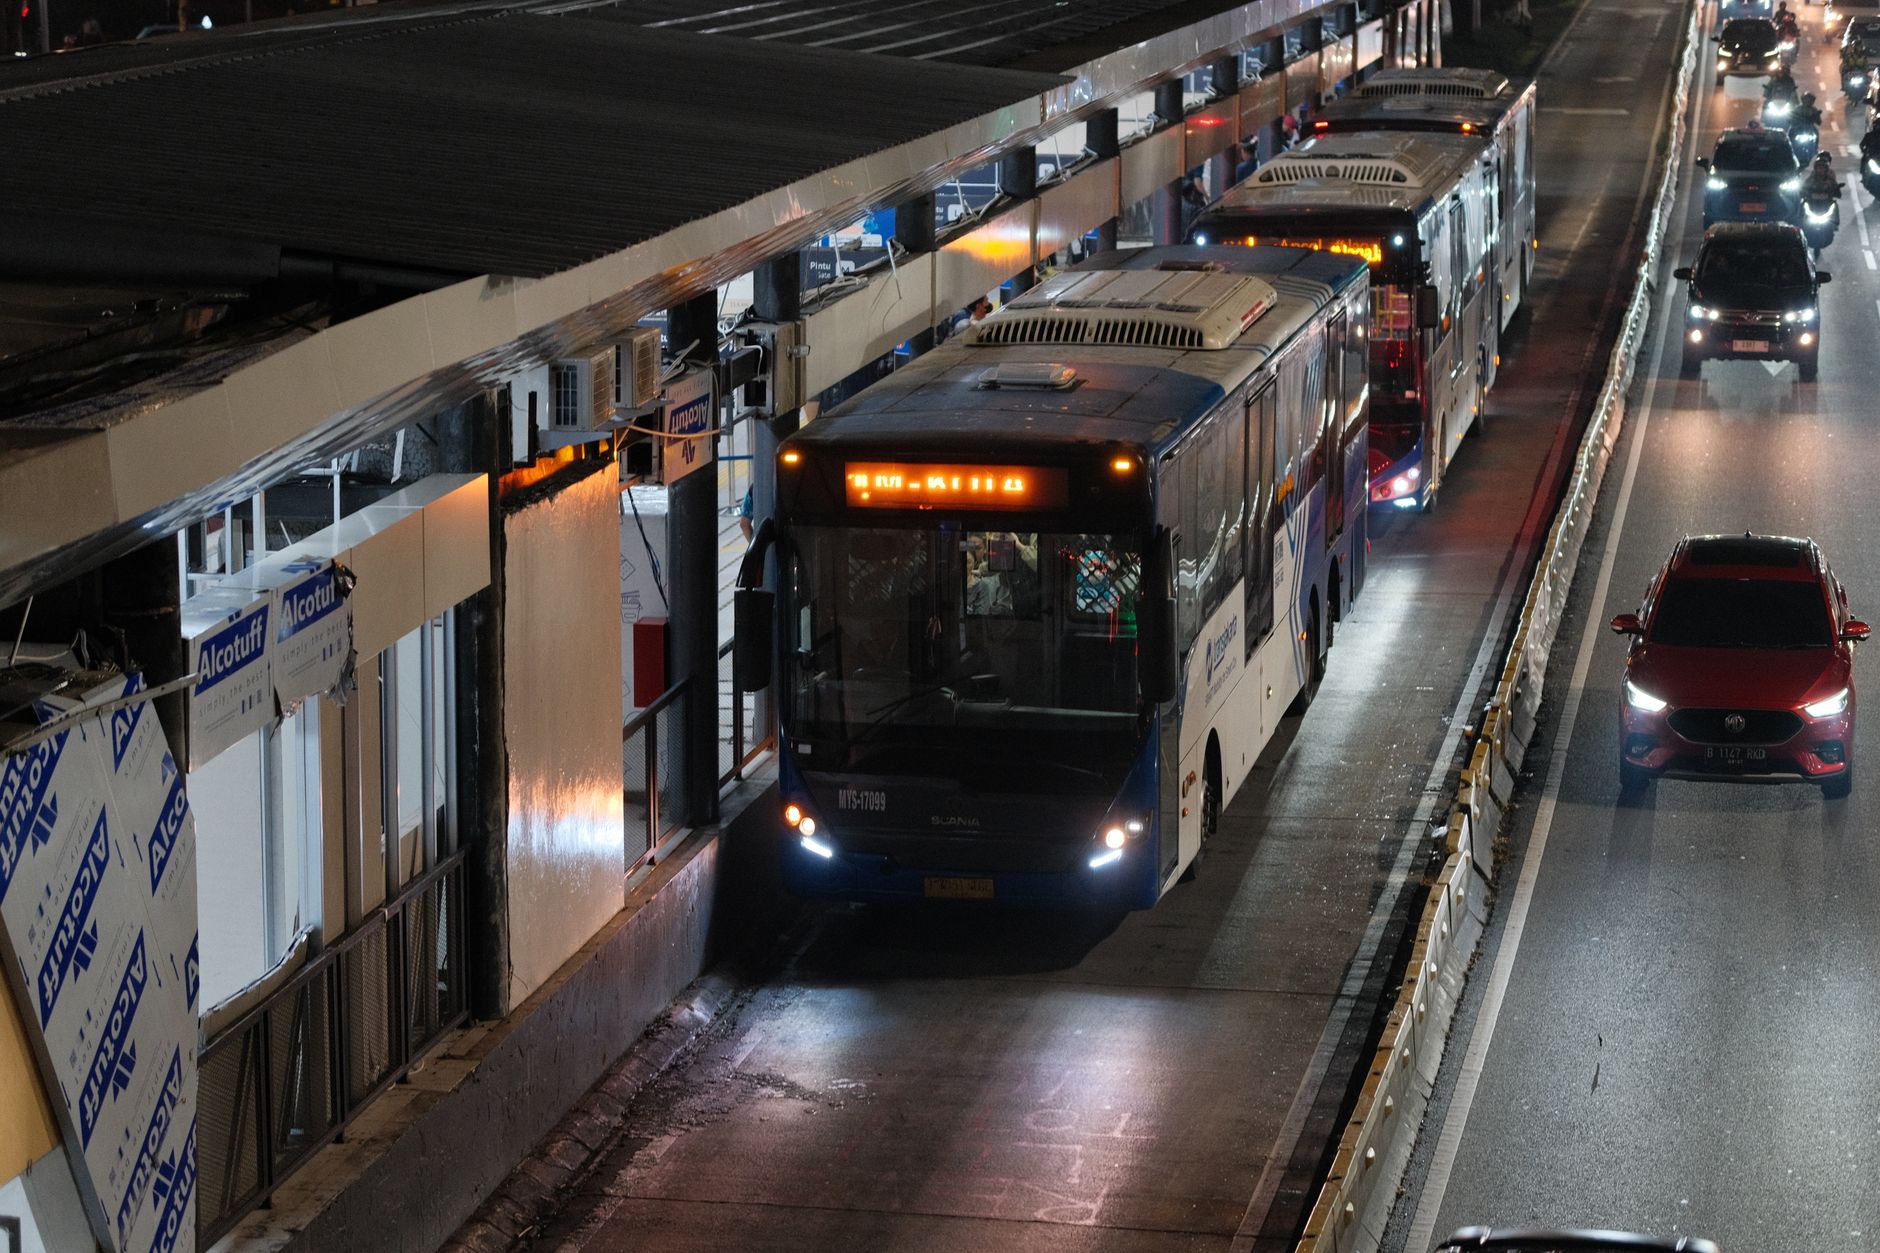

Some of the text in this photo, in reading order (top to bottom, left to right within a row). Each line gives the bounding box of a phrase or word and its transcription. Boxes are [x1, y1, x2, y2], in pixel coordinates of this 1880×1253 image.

[810, 261, 831, 270] Pintu
[281, 583, 337, 628] Alcotuf
[199, 614, 263, 683] Alcotuff
[839, 789, 886, 812] MYS-17099
[931, 816, 980, 826] SCANIA
[42, 820, 108, 1009] Alcotuff
[82, 942, 147, 1131] Alcotuff
[120, 1062, 182, 1236] Alcotuff
